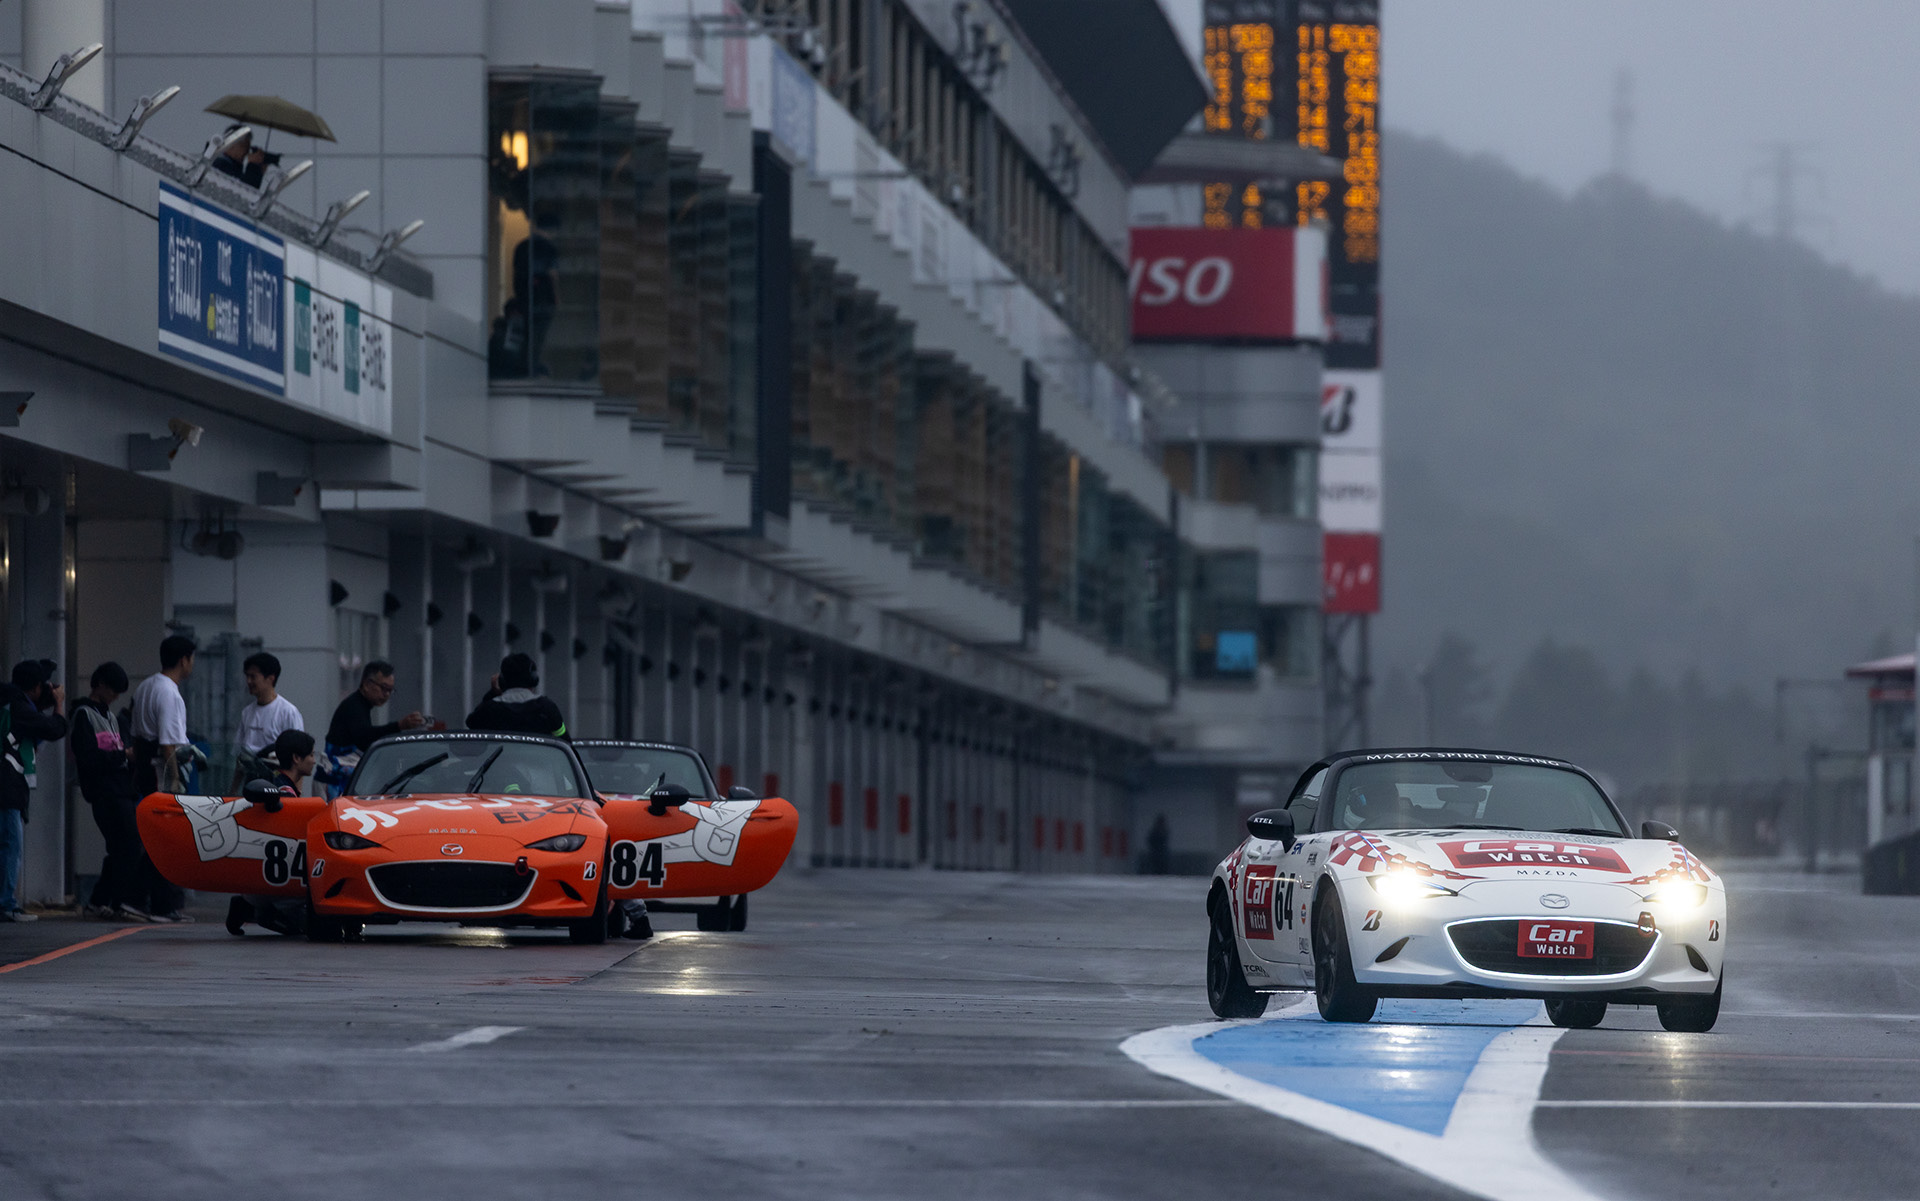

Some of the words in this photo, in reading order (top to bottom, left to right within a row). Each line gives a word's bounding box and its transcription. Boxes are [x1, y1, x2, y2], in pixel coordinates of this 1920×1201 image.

[395, 734, 444, 742] MAZDA
[495, 734, 545, 743] RACING
[629, 742, 676, 750] RACING
[1366, 753, 1431, 761] MAZDA
[1437, 752, 1488, 760] SPIRIT
[1495, 755, 1559, 766] RACING
[492, 802, 597, 825] EDGE
[1463, 840, 1597, 855] Car
[610, 839, 666, 889] 84
[1487, 852, 1591, 865] Watch
[1516, 869, 1579, 877] MAZDA
[1245, 872, 1271, 905] Car
[1275, 871, 1296, 931] 64
[1249, 910, 1267, 930] Watch
[1529, 924, 1584, 943] Car
[1536, 943, 1576, 956] Watch
